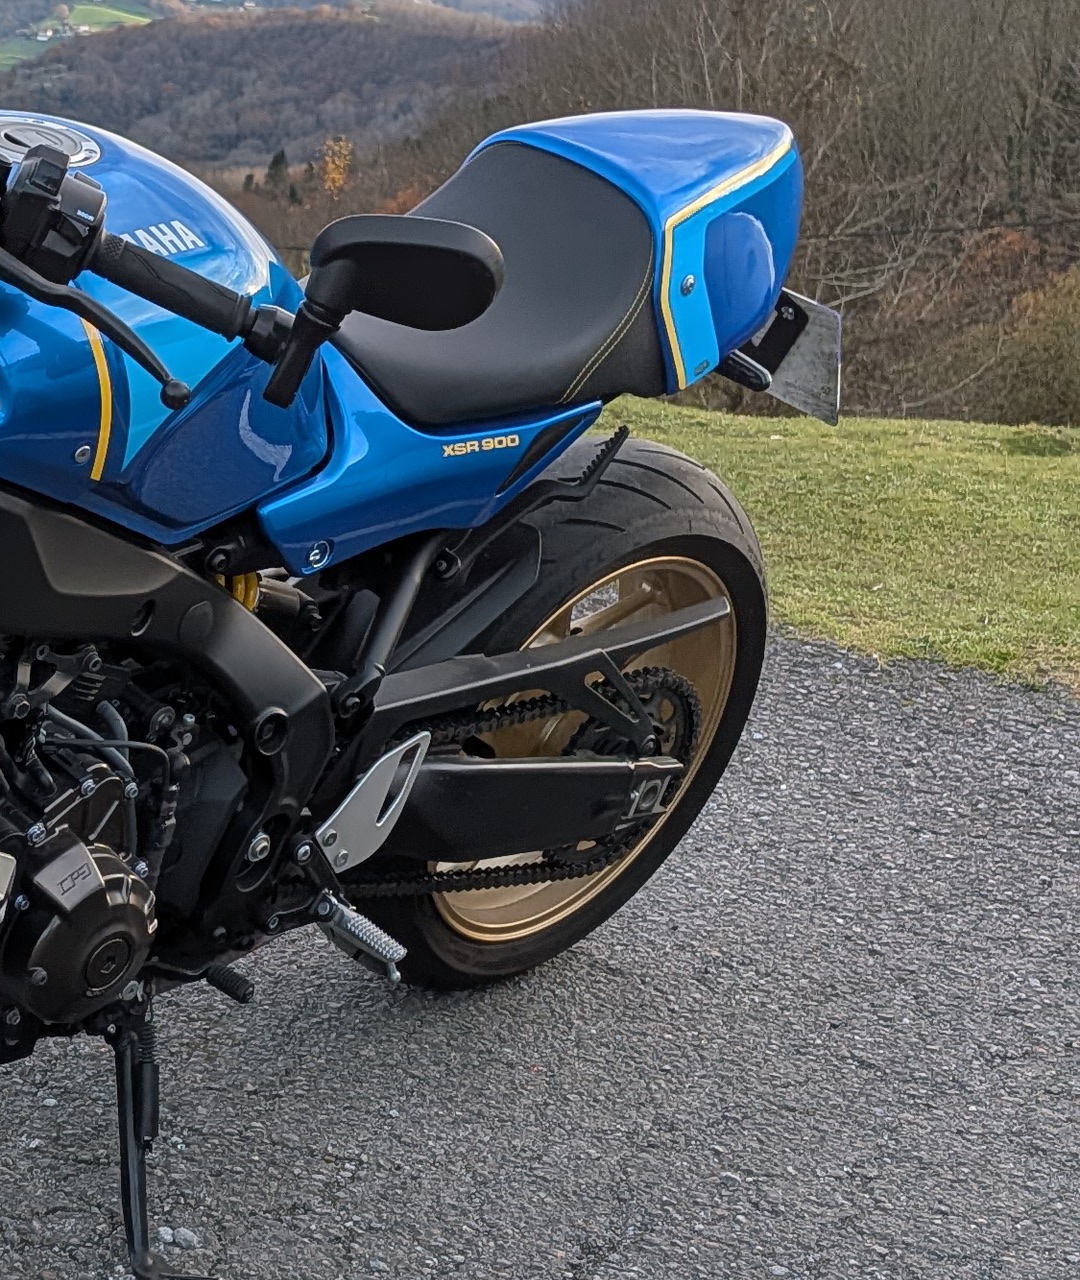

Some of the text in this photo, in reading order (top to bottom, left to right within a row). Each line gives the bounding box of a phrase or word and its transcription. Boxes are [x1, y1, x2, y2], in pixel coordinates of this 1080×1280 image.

[120, 220, 206, 257] AHA
[442, 434, 520, 458] XSR 900
